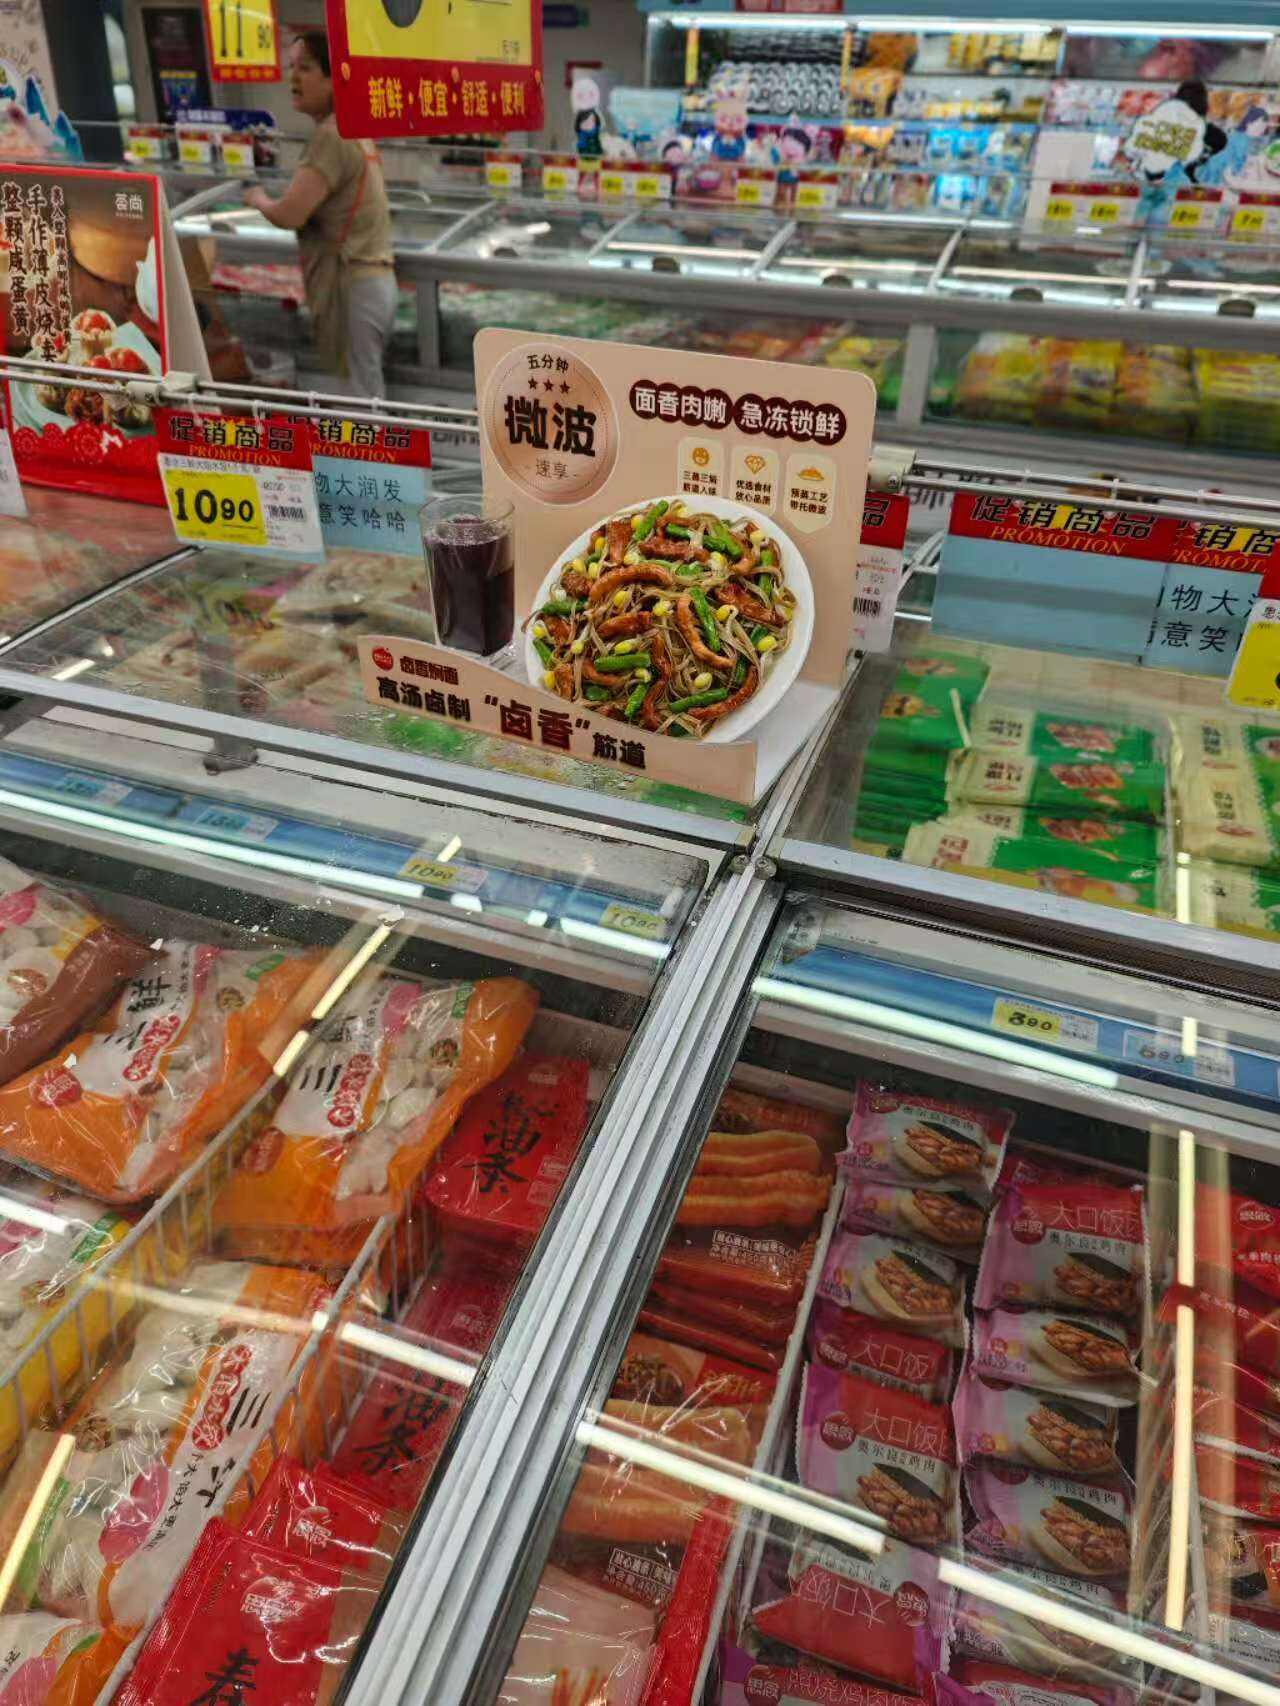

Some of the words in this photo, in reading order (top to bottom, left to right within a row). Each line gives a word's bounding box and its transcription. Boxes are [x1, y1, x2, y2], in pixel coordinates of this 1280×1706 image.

[527, 354, 569, 374] 五分钟
[504, 395, 597, 457] 微波
[635, 386, 727, 424] 面香肉嫩
[740, 400, 840, 440] 急冻锁鲜
[170, 415, 294, 451] 促销商品
[318, 417, 411, 450] 销商品
[188, 443, 282, 466] PROMOTION
[309, 441, 397, 464] ROMOTION
[971, 494, 1154, 541] 促销商品
[991, 525, 1127, 557] PROMOTION
[376, 676, 472, 722] 高汤卤制
[592, 731, 647, 770] 筋道
